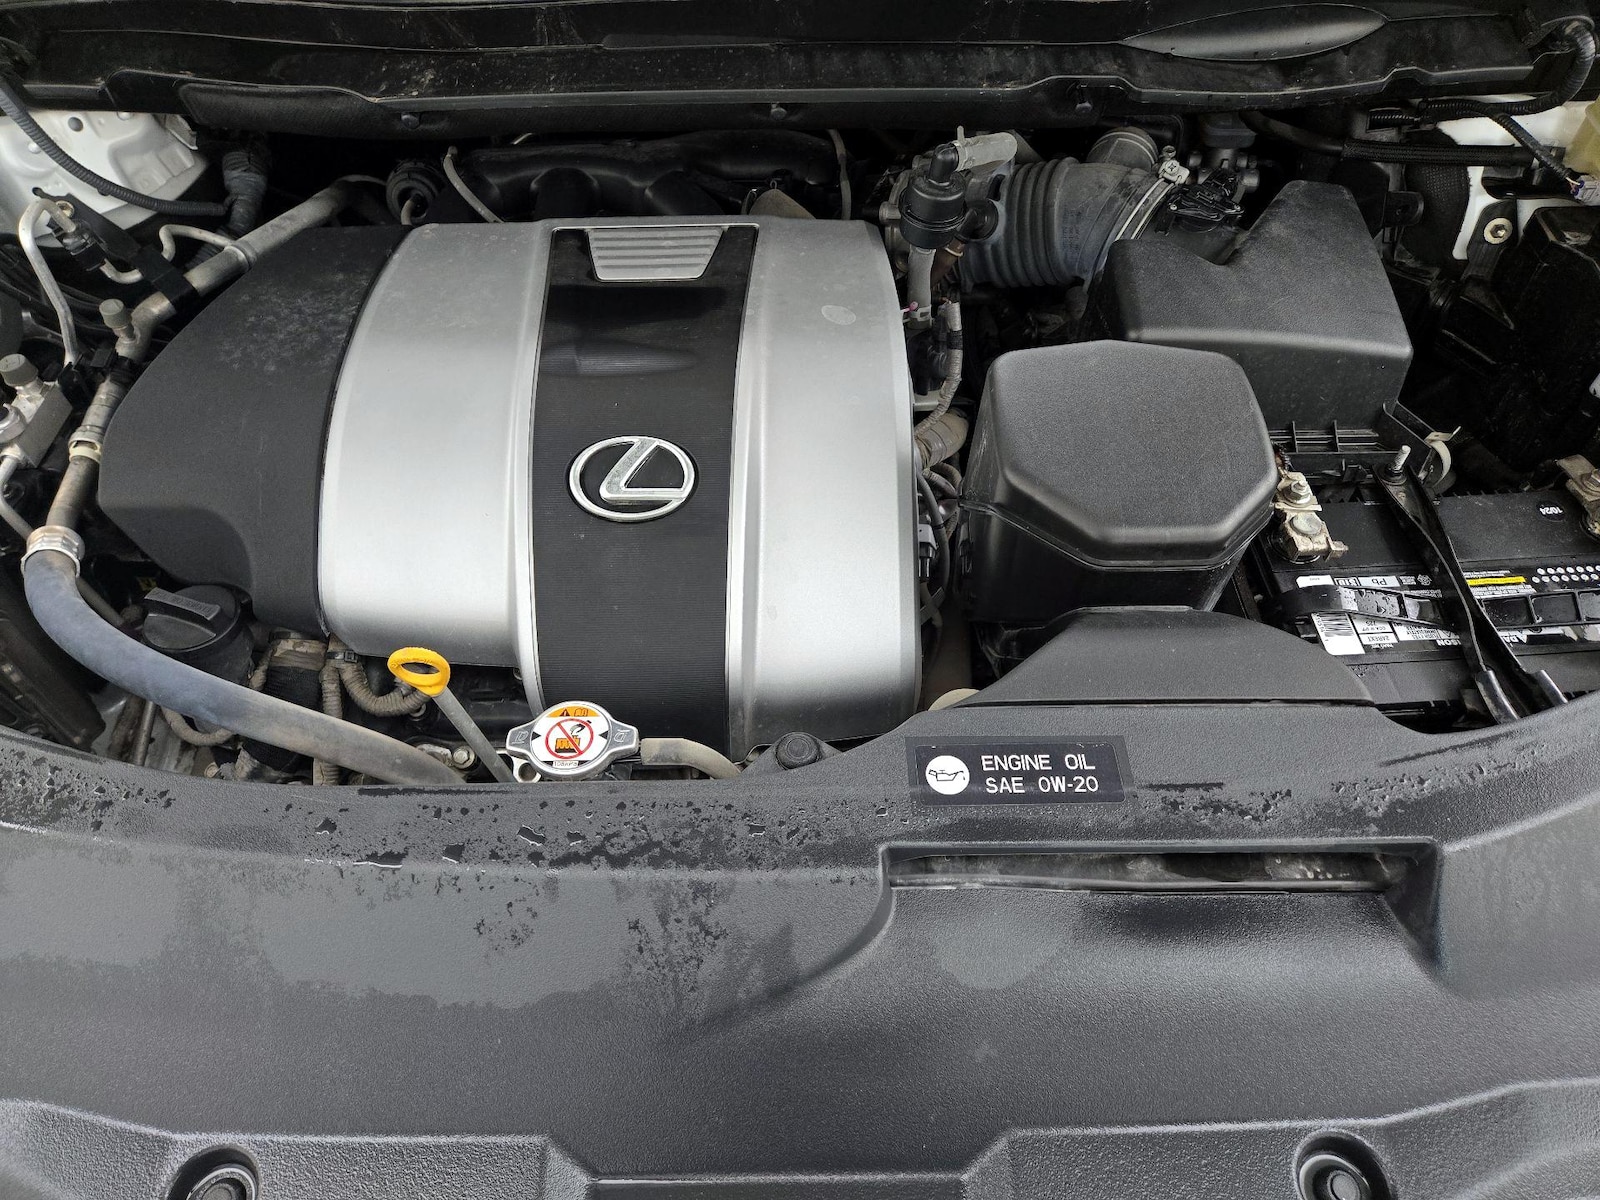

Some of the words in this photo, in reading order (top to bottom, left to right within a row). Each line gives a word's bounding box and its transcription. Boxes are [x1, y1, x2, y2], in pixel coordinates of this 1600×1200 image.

[1539, 506, 1564, 515] 10/24
[1371, 578, 1388, 586] Pb
[981, 754, 1052, 771] ENGINE
[1064, 753, 1096, 770] OIL
[985, 776, 1026, 794] SAE
[1038, 775, 1099, 793] 0W-20
